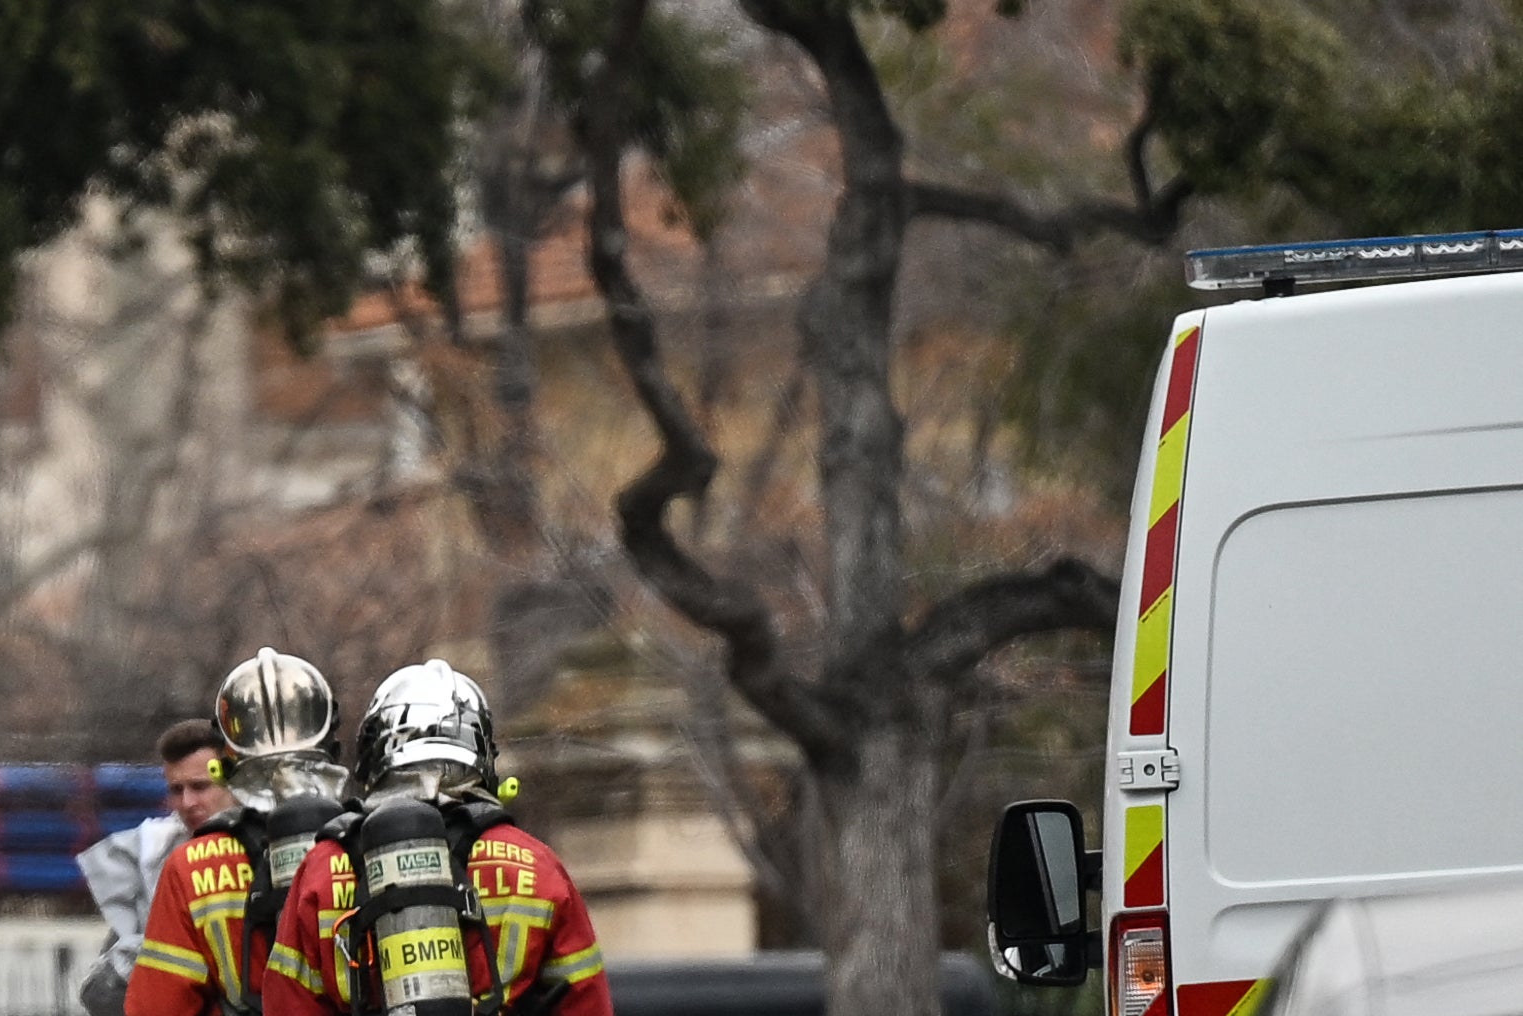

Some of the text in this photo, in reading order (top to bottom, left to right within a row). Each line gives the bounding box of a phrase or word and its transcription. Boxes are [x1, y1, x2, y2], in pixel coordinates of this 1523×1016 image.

[330, 840, 535, 874] M PIERS
[399, 854, 439, 869] MSA
[473, 867, 535, 896] LLE
[402, 939, 463, 965] BMPM
